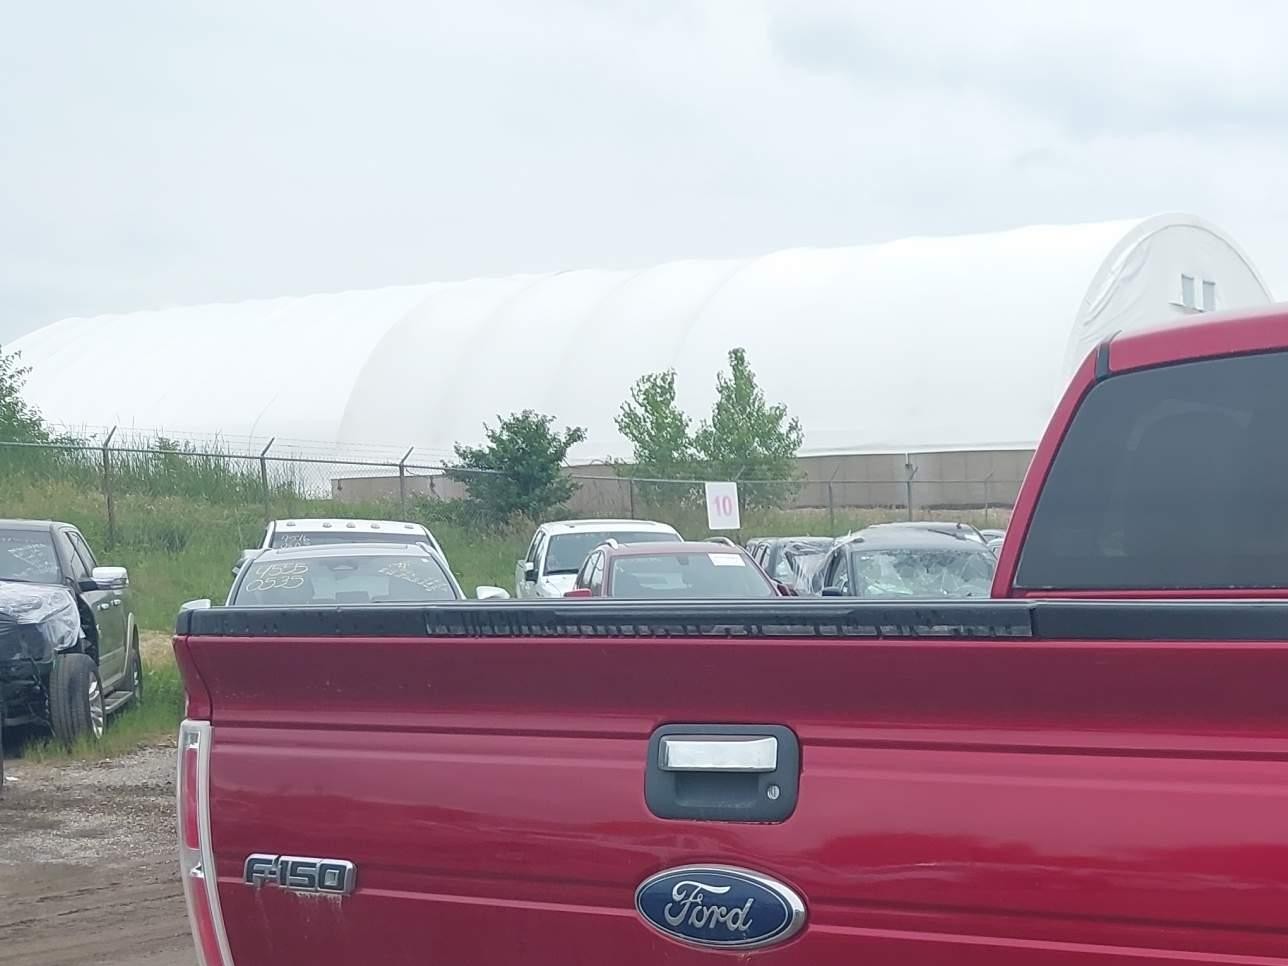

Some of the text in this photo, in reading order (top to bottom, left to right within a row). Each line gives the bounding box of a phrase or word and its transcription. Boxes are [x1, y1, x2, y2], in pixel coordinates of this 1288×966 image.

[714, 495, 732, 517] 10
[245, 854, 350, 891] F-150
[664, 880, 754, 932] Ford
